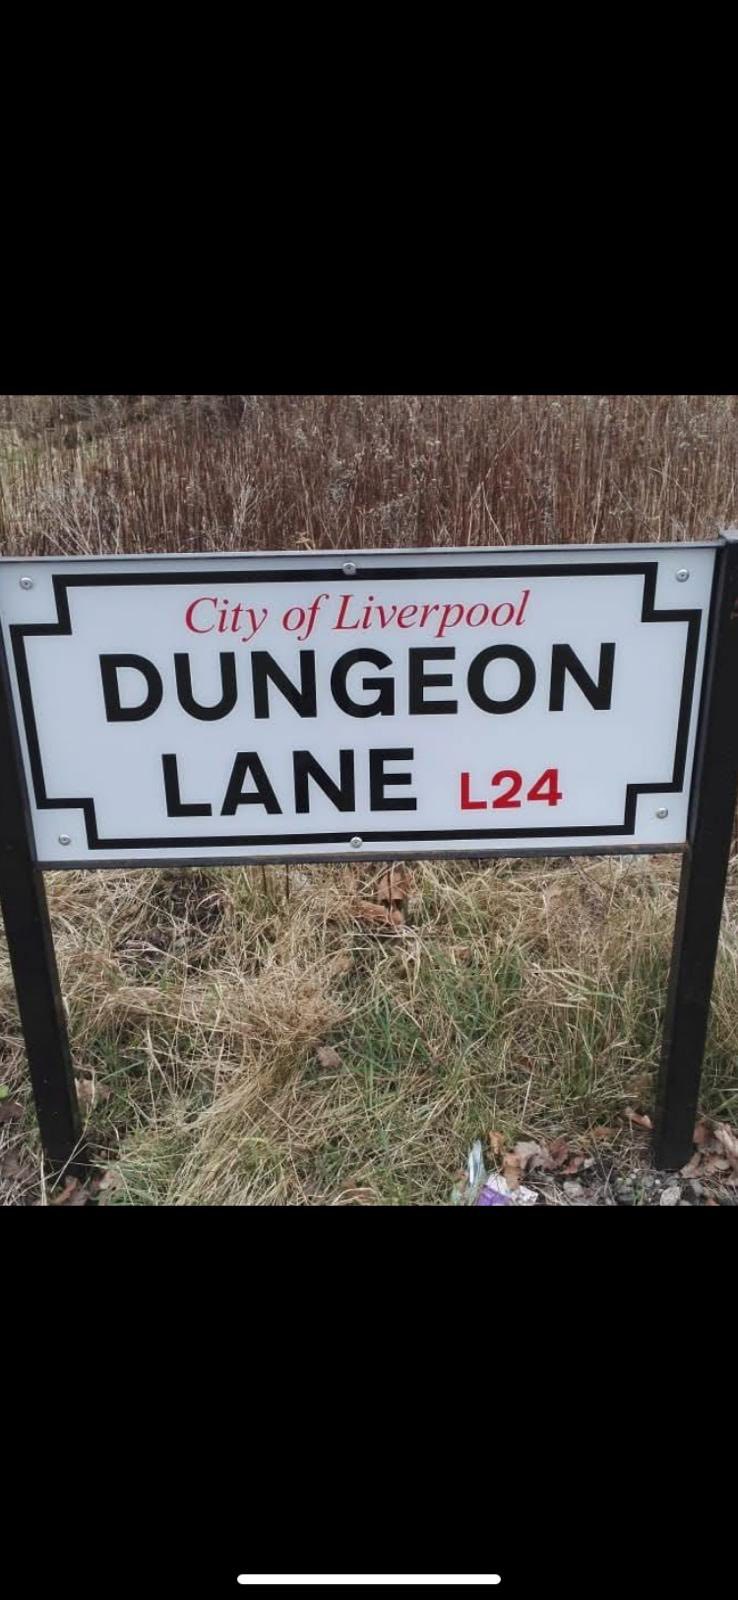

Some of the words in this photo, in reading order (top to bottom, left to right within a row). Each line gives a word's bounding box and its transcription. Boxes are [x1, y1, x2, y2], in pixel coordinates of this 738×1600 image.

[184, 597, 268, 642] City
[282, 593, 329, 640] of
[332, 590, 531, 638] Liverpool
[99, 643, 615, 722] DUNGEON
[162, 748, 417, 817] LANE
[459, 768, 564, 811] L24
